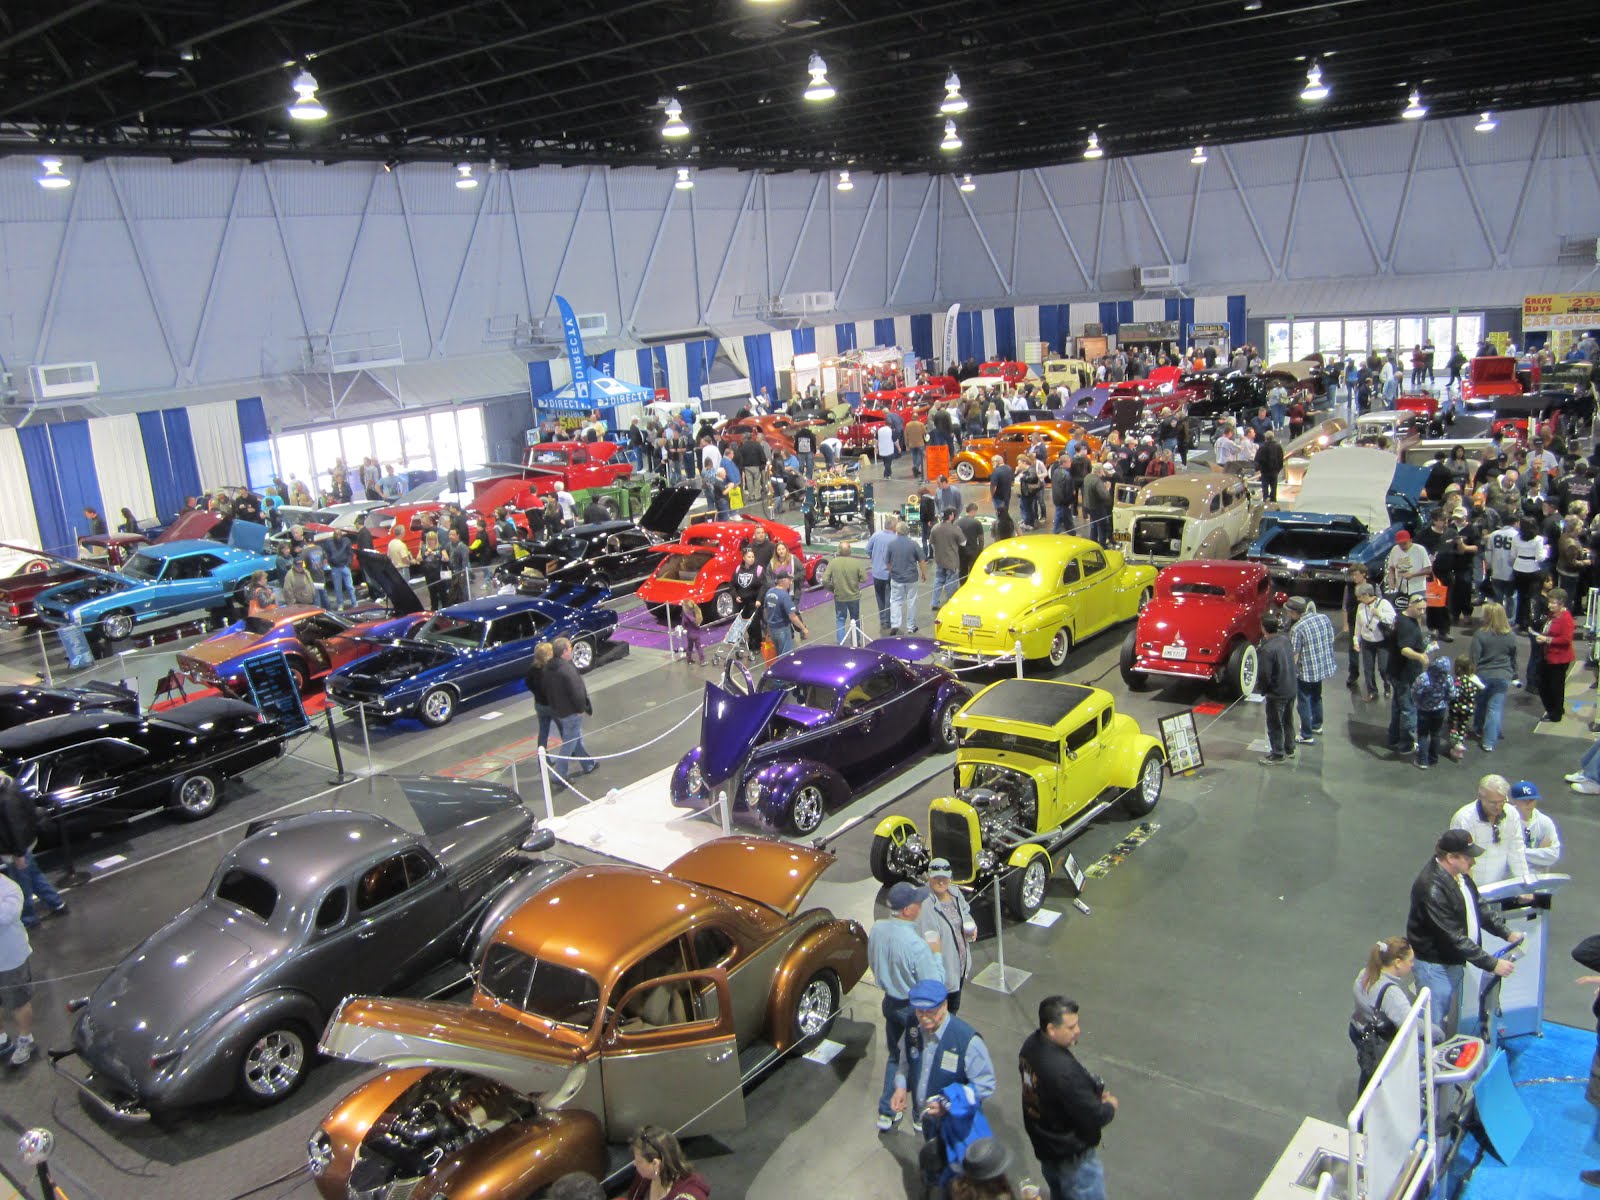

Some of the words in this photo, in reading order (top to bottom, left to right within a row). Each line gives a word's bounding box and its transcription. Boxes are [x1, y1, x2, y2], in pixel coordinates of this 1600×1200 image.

[1524, 297, 1553, 305] GREAT
[1524, 305, 1552, 313] BUYS
[1523, 316, 1550, 328] CAR
[610, 391, 649, 405] DIRECTV
[1494, 534, 1512, 550] 86
[1522, 785, 1532, 795] KC
